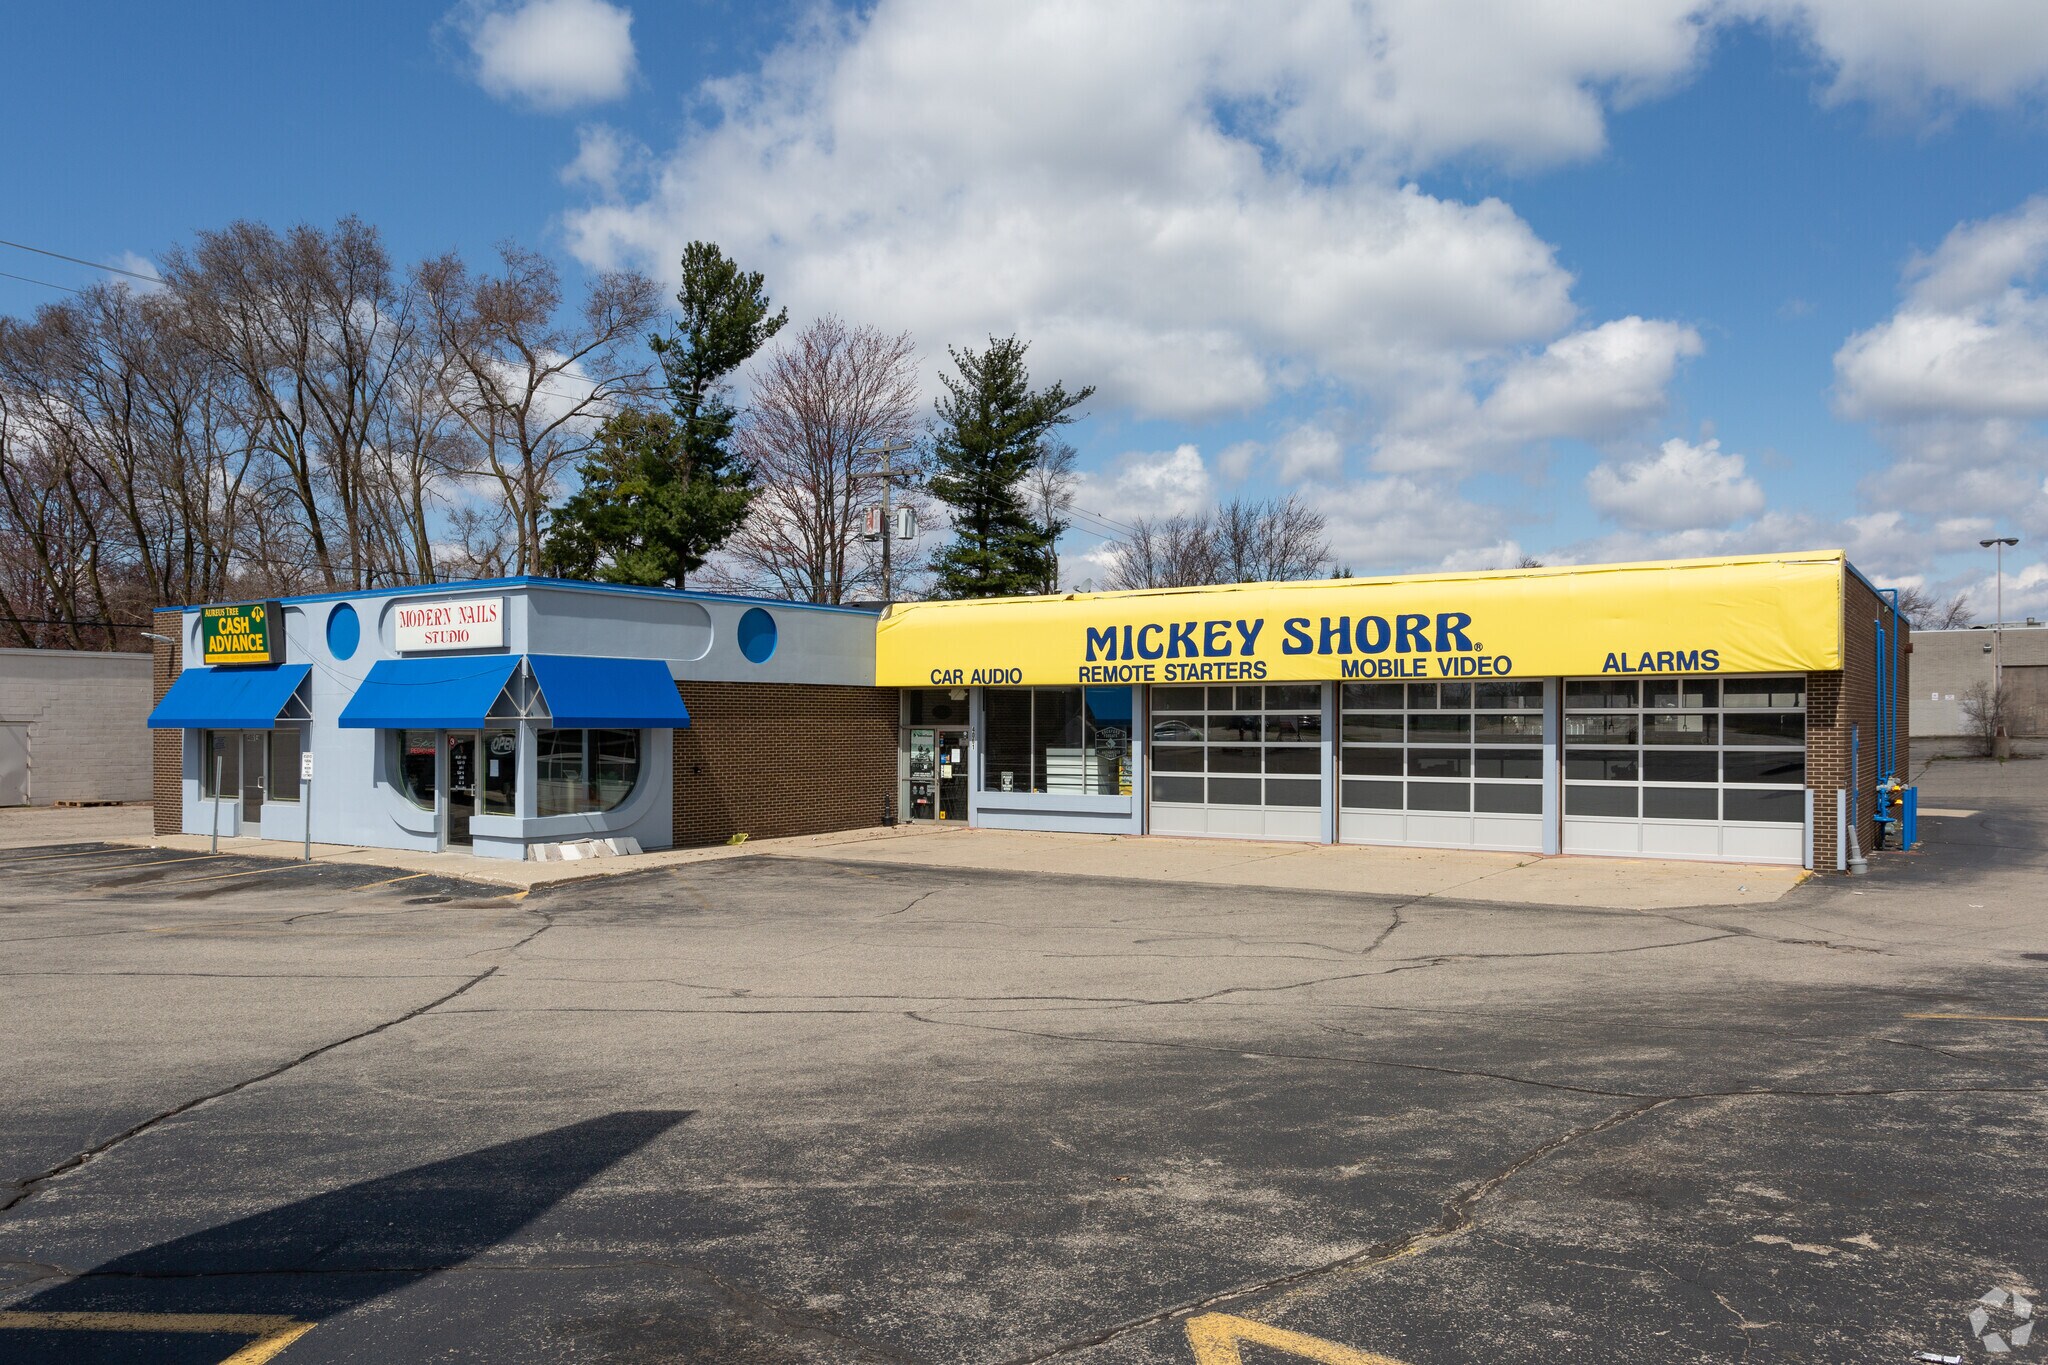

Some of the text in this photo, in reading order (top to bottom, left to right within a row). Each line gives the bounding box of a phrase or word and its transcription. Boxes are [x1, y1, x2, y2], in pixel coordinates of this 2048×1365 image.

[204, 607, 239, 617] AUREUS TREE
[399, 604, 497, 628] MODERN NAILS
[218, 616, 250, 635] CASH
[209, 633, 264, 652] ADVANCE
[425, 629, 470, 644] STUDIO
[1085, 619, 1265, 662] MICKEY
[1079, 661, 1267, 684] REMOTE STARTERS
[1341, 655, 1512, 680] MOBILE VIDEO
[1602, 649, 1719, 675] ALARMS
[930, 667, 1023, 685] CAR AUDIO
